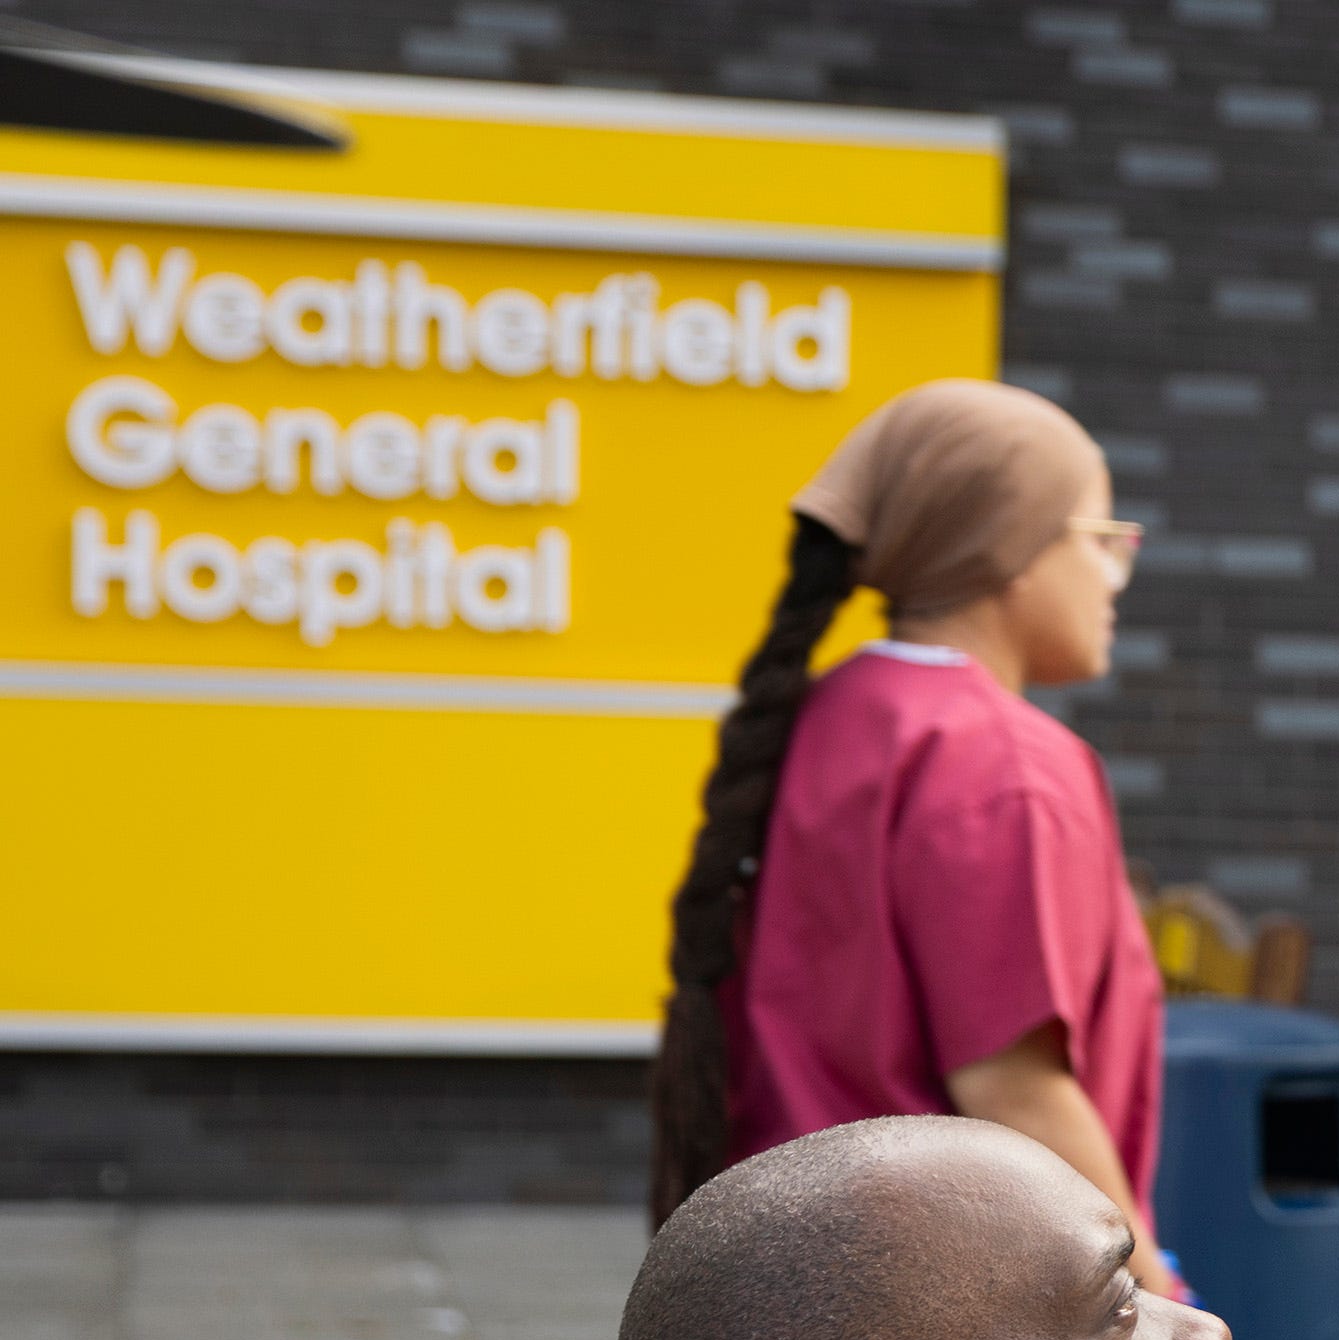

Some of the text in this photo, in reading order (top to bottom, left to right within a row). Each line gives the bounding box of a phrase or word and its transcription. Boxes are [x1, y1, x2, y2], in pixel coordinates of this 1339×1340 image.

[65, 240, 851, 391] Weatherfield
[66, 374, 580, 505] General
[71, 507, 570, 646] Hospital
